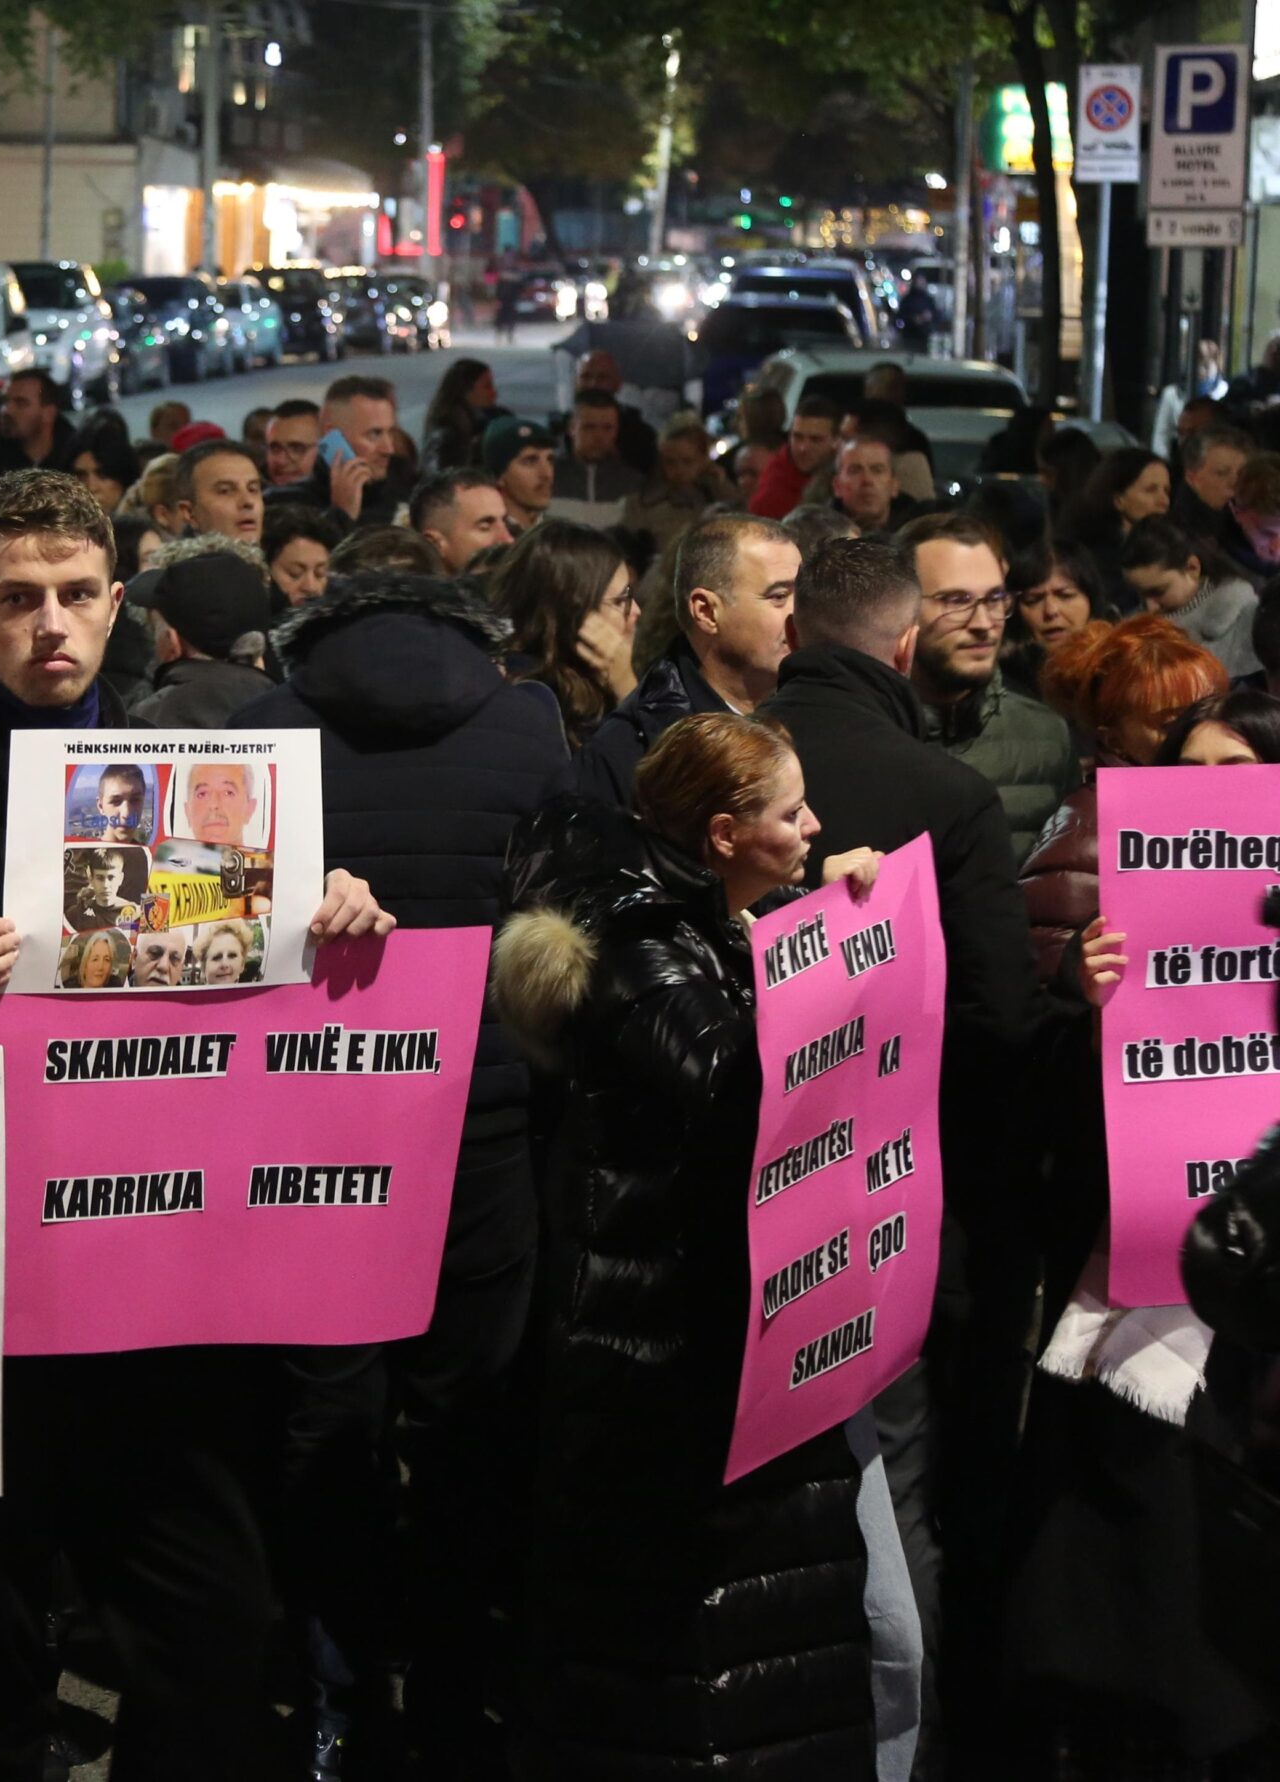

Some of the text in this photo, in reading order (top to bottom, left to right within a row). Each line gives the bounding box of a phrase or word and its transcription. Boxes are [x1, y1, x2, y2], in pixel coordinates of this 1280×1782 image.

[1177, 58, 1226, 130] P
[135, 743, 176, 754] KOKAT
[179, 743, 186, 754] E
[787, 912, 829, 974] KËTË
[840, 919, 896, 977] VEND!
[1154, 946, 1191, 985] të
[45, 1026, 440, 1081] SKANDALET VINË E IKIN,
[785, 1015, 900, 1092] KARRIKJA KA
[1126, 1039, 1163, 1079] të
[756, 1118, 914, 1201] JETËGJATËSI MË TË
[44, 1166, 392, 1219] KARRIKJA MBETET!
[763, 1214, 905, 1316] MADHE SE ÇDO
[792, 1310, 874, 1386] SKANDAL
